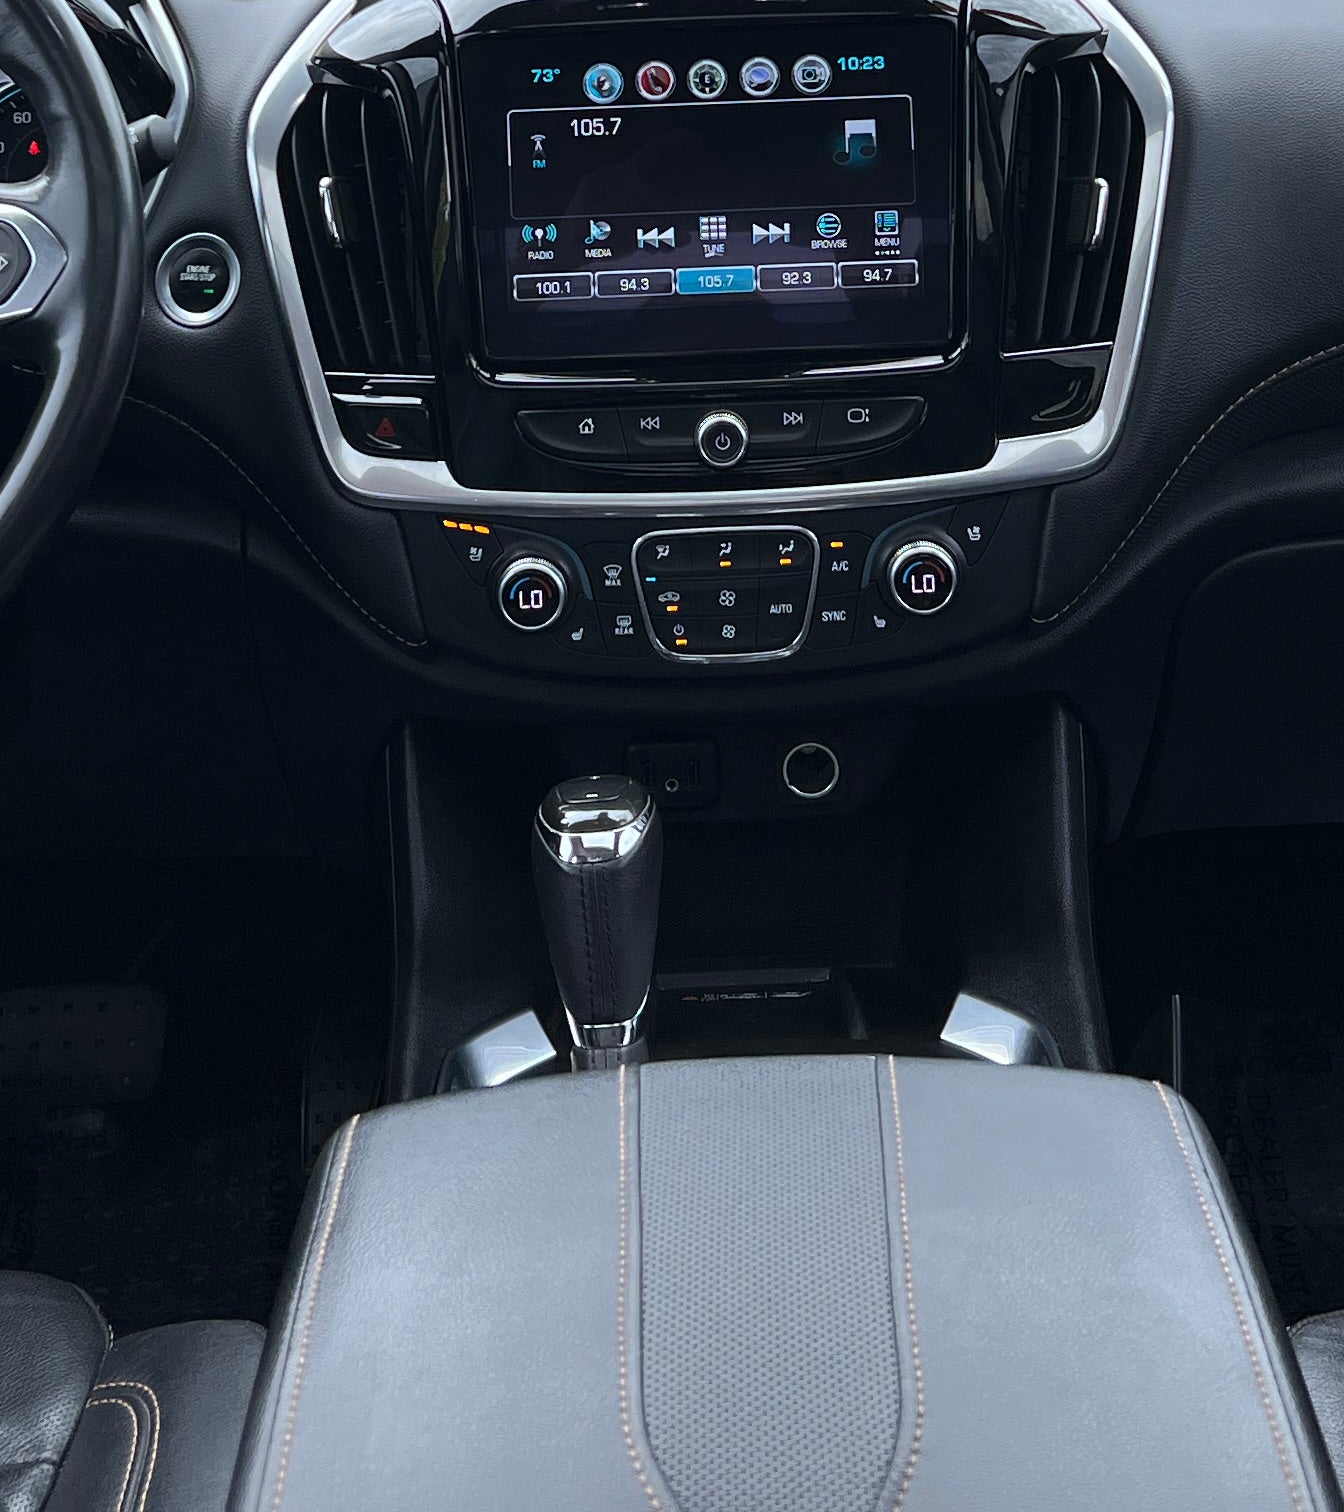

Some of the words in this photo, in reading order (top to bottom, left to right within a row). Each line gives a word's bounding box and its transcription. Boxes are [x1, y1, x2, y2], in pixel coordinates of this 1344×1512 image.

[837, 56, 885, 71] 10:23
[531, 68, 561, 83] 73°
[13, 112, 32, 124] 60
[570, 118, 622, 137] 105.7
[533, 159, 546, 169] FM
[703, 244, 725, 253] TUNE
[811, 240, 847, 249] BROWSE
[875, 238, 900, 247] MENU
[528, 251, 554, 260] RADIO
[585, 249, 612, 258] MEDIA
[186, 265, 211, 273] ENGINE
[698, 275, 734, 288] 105.7
[782, 272, 812, 285] 92.3
[863, 269, 893, 282] 94.7
[536, 281, 571, 295] 100.1
[620, 278, 650, 292] 94.3
[831, 561, 849, 572] A/C
[911, 574, 935, 593] LO
[519, 590, 543, 609] LO
[769, 603, 793, 615] AUTO
[821, 611, 847, 622] SYNC
